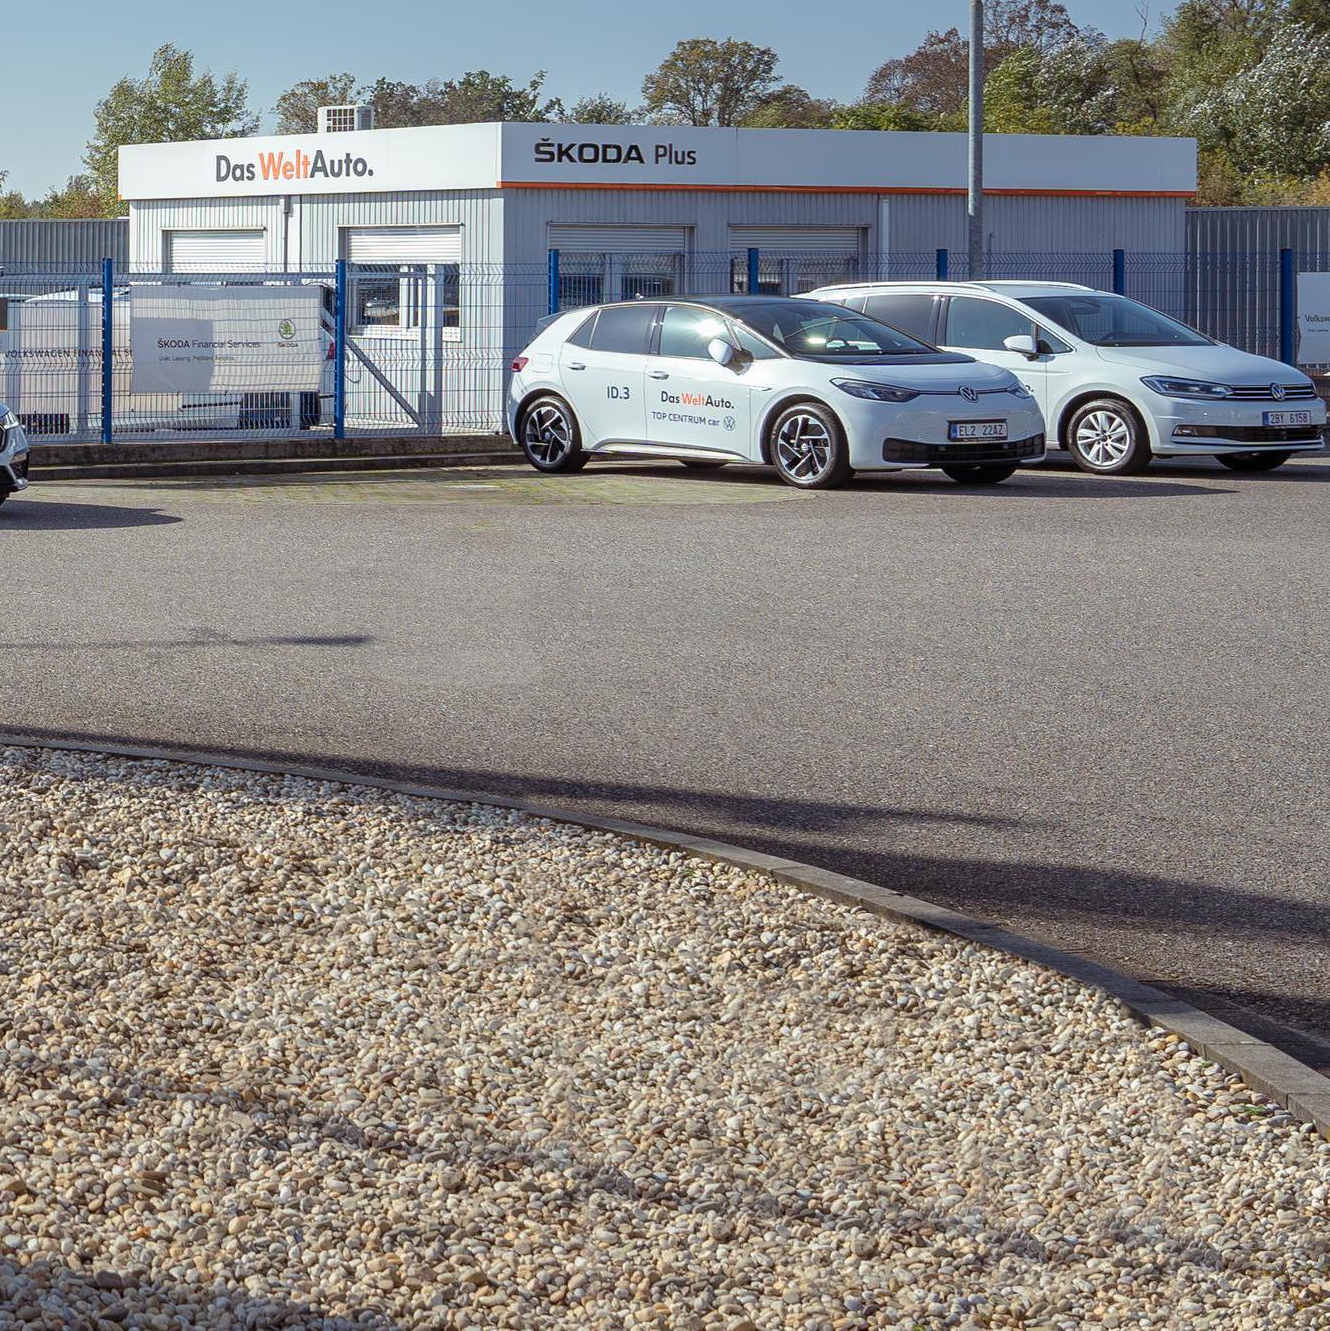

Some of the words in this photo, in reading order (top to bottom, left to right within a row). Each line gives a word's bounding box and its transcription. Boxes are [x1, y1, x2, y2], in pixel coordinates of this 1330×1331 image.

[534, 138, 645, 164] ŠKODA
[655, 143, 697, 165] Plus
[216, 155, 256, 182] Das
[259, 149, 374, 180] WeltAuto.
[157, 337, 191, 349] ŠKODA
[192, 339, 226, 349] Financial
[227, 339, 261, 349] Services
[5, 350, 71, 358] VOLKSWAGEN
[606, 386, 630, 400] ID.3
[660, 391, 681, 404] Das
[682, 393, 735, 409] WeltAuto.
[652, 411, 667, 420] TOP
[668, 414, 707, 425] CENTRUM
[708, 419, 720, 427] car
